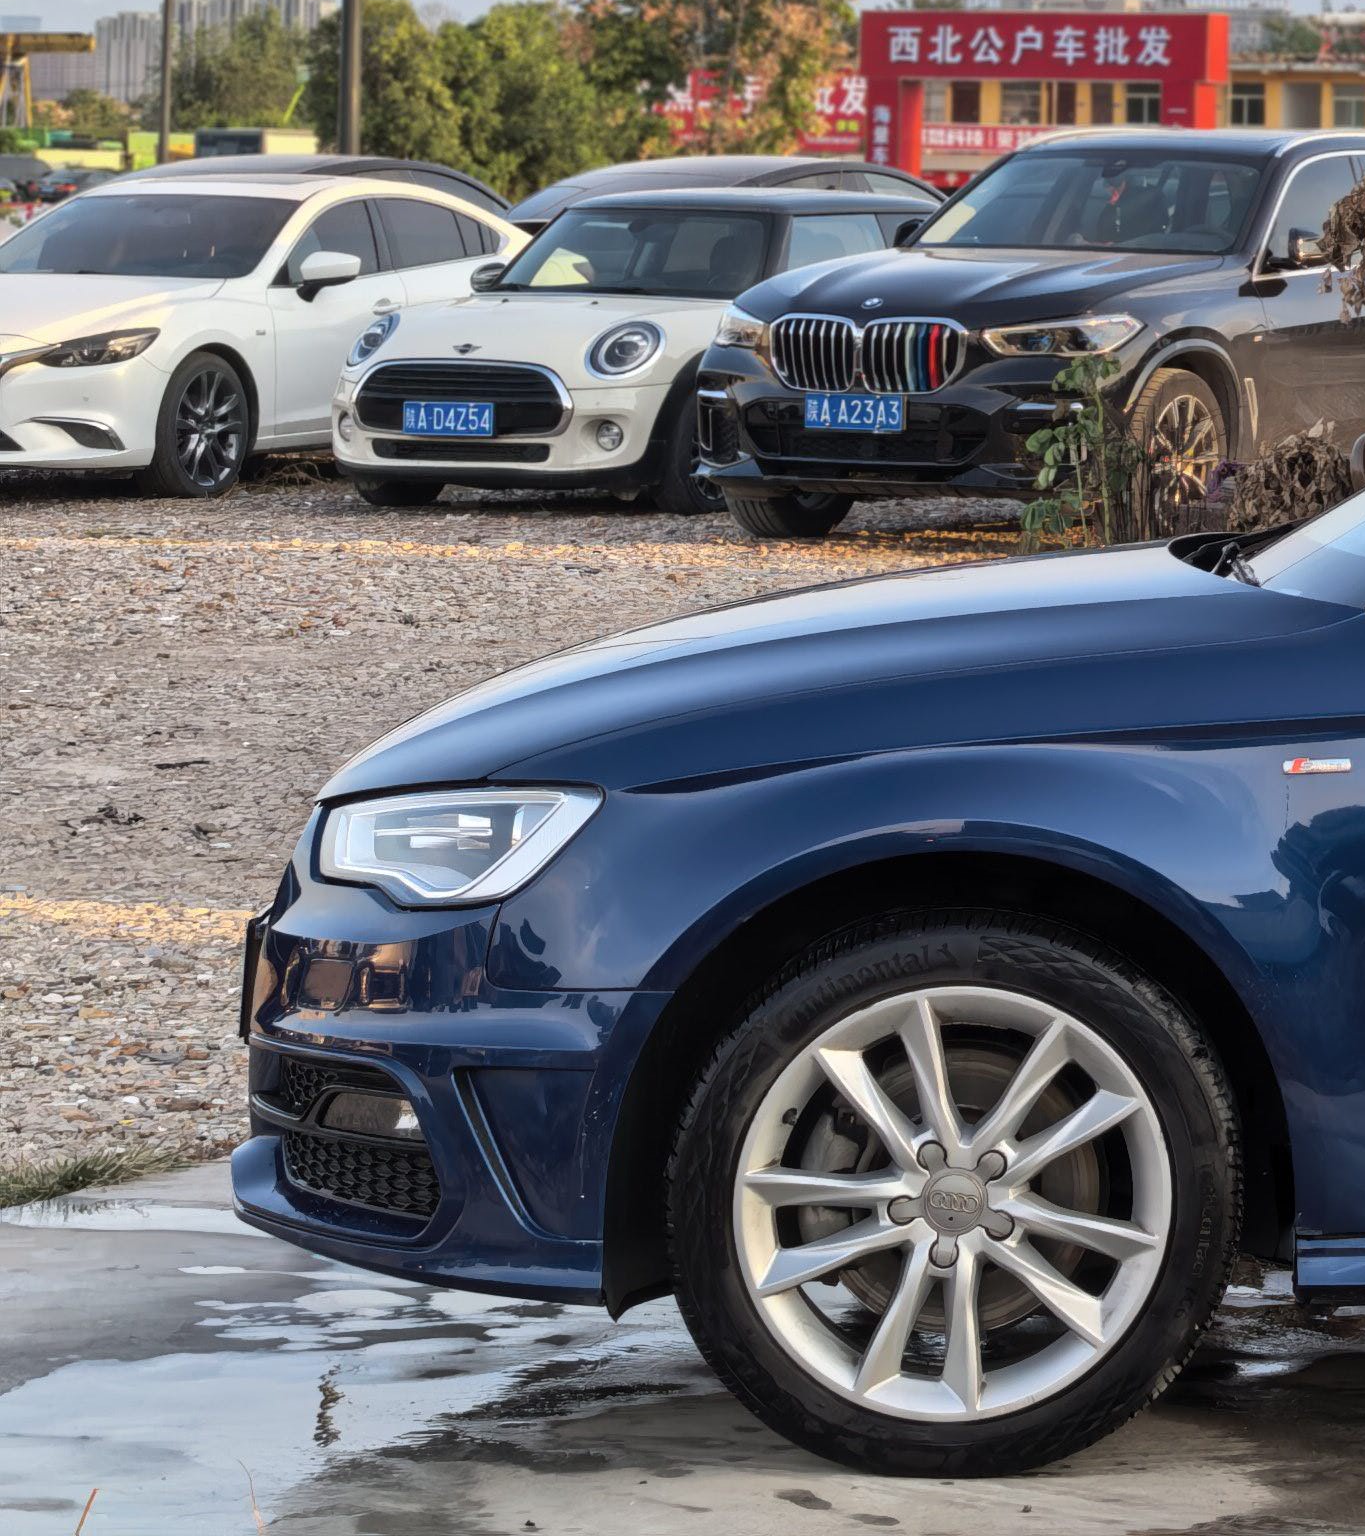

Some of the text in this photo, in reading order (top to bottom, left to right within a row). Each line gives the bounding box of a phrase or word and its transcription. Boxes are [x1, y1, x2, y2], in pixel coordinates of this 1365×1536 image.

[888, 25, 1171, 65] 西北公户车批发
